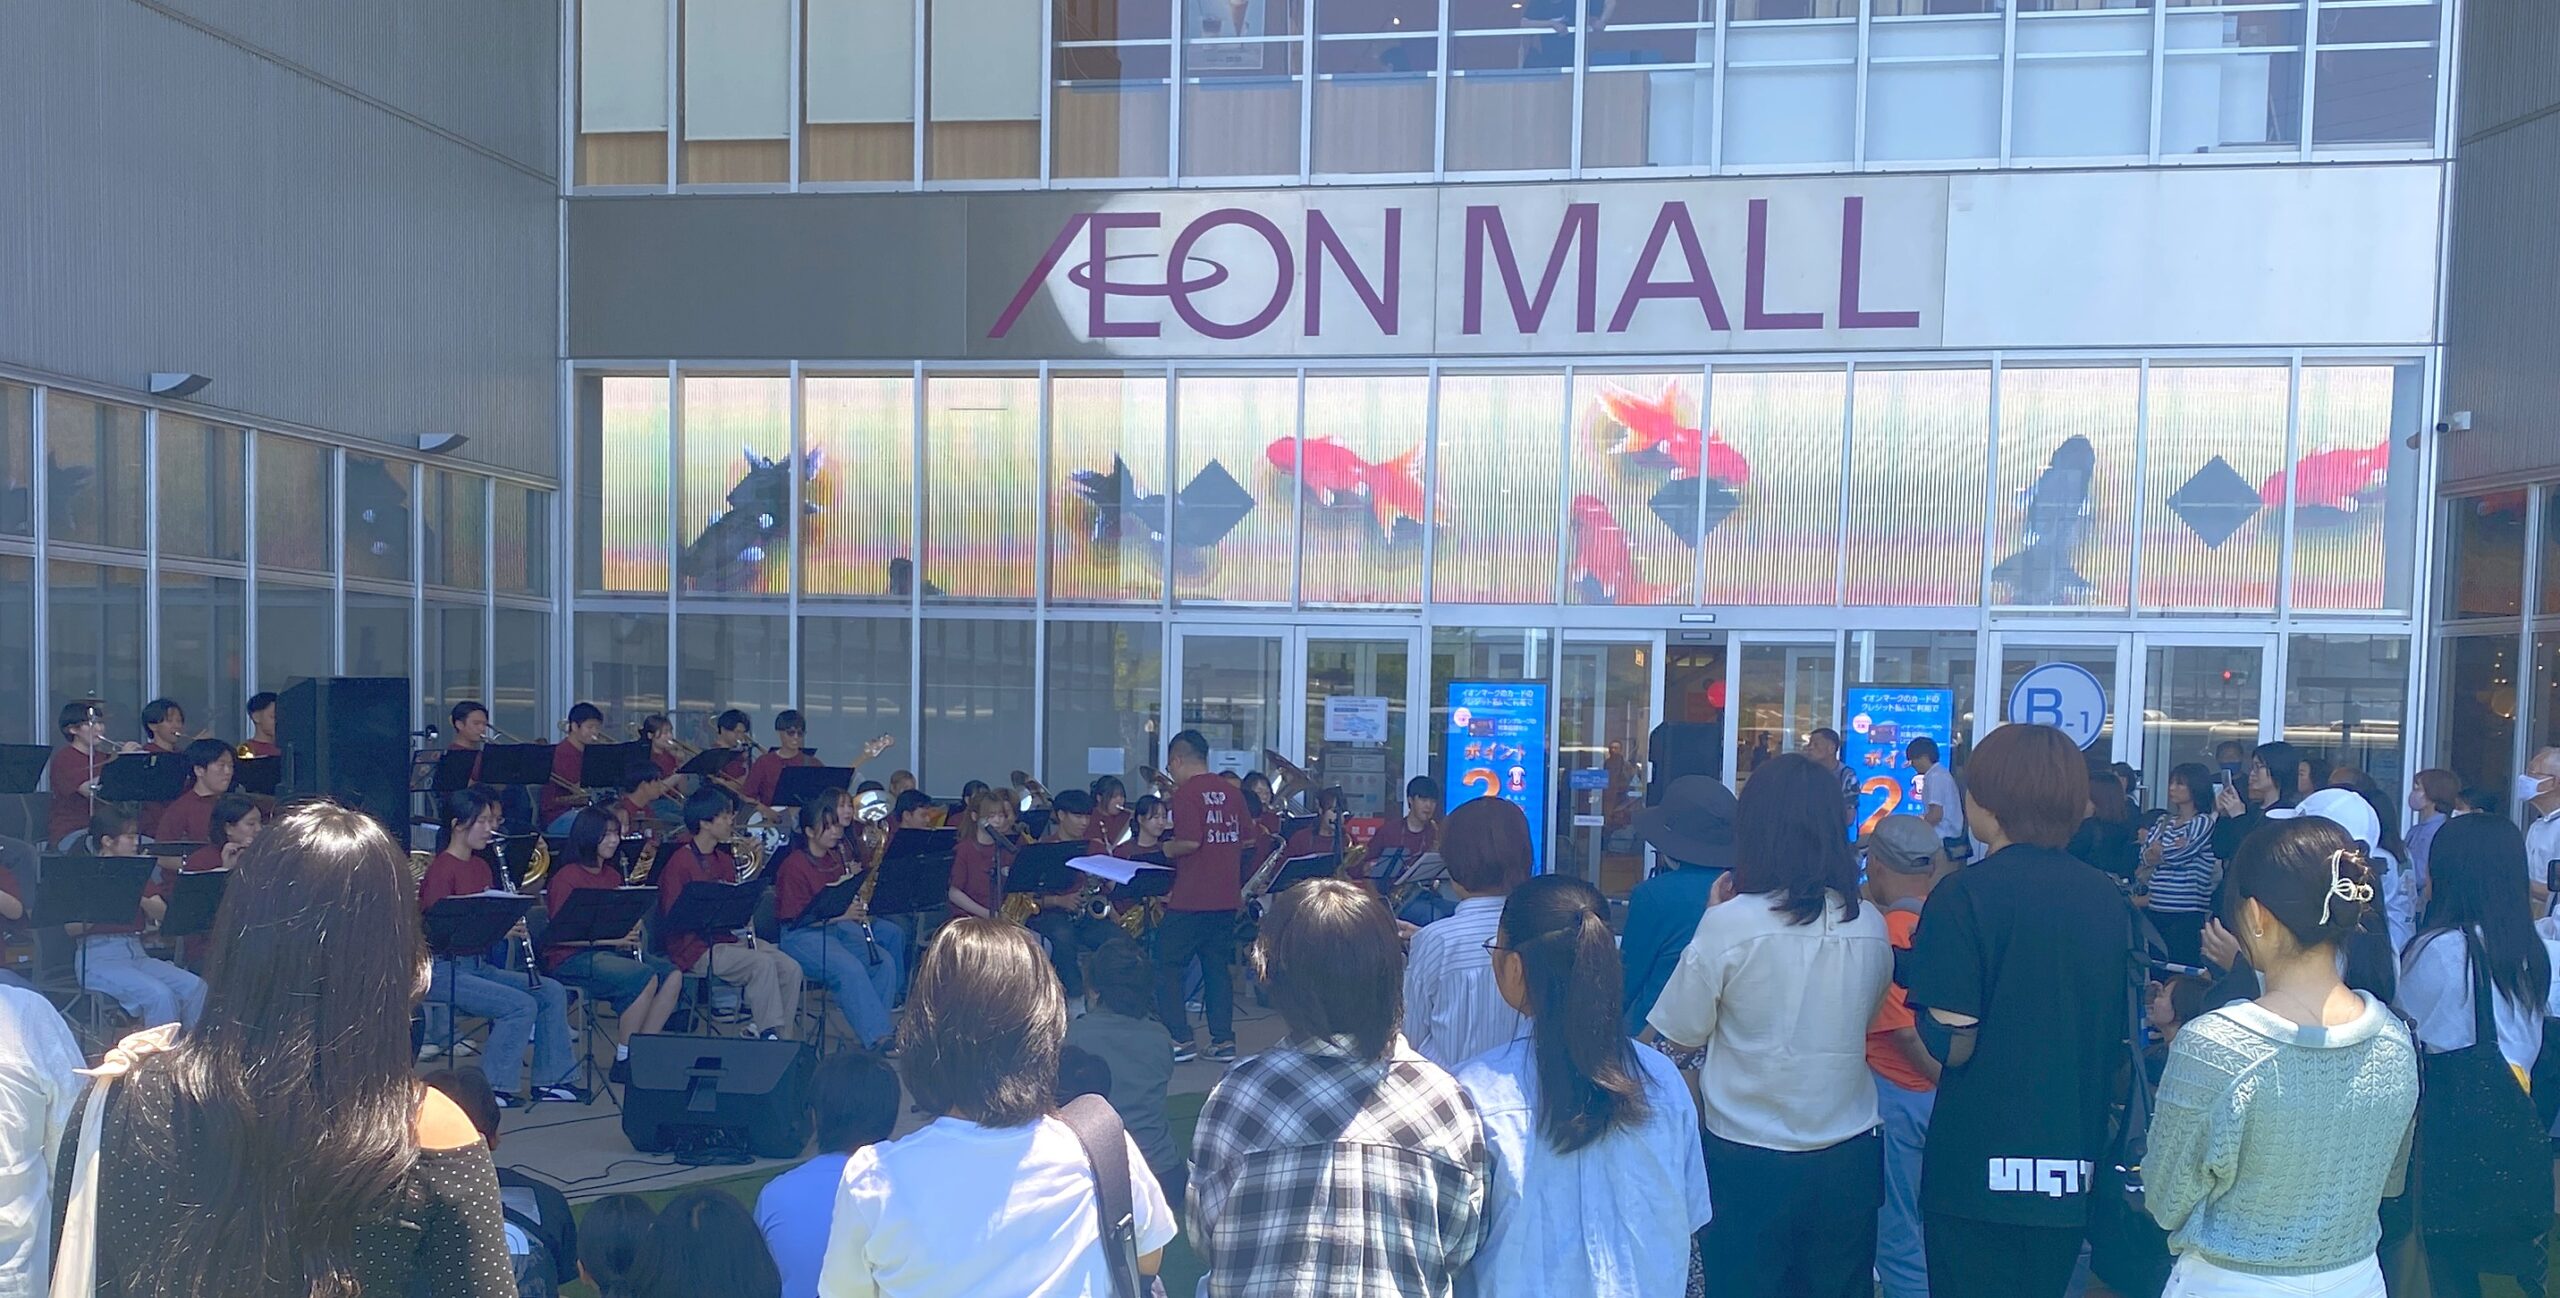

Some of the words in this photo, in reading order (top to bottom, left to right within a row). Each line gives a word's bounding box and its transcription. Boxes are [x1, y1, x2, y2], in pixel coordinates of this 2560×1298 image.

[1461, 196, 1921, 334] MALL
[1861, 694, 1940, 703] イオンマークのカードの
[2026, 687, 2089, 734] B-1
[1464, 741, 1526, 760] ポイント
[1863, 749, 1911, 769] ポイ
[1201, 791, 1226, 805] KSP
[1859, 775, 1902, 834] 2
[1206, 810, 1223, 823] All
